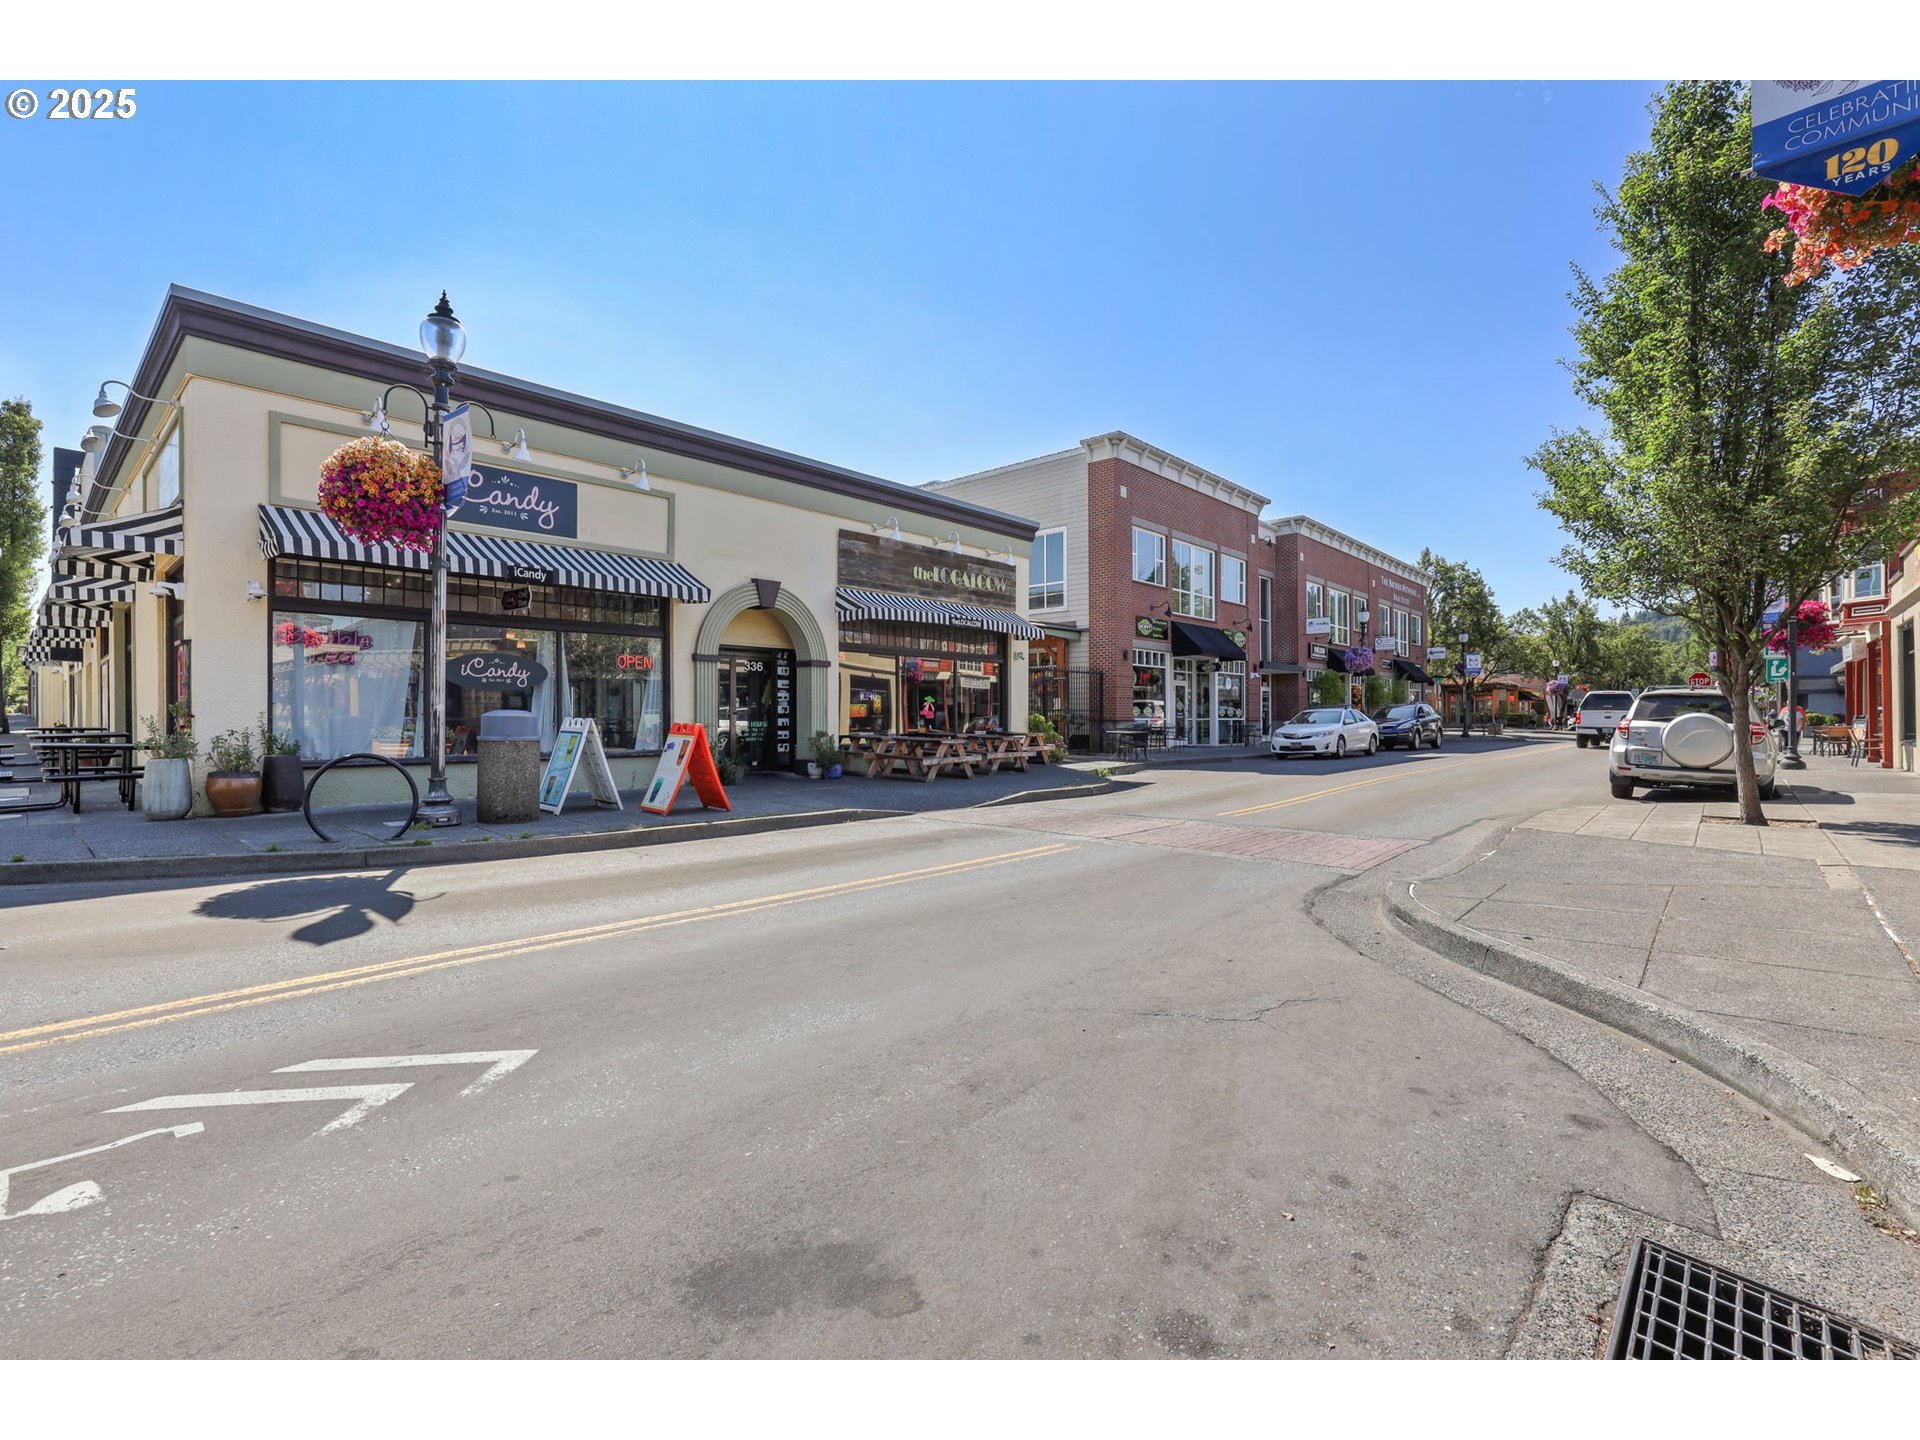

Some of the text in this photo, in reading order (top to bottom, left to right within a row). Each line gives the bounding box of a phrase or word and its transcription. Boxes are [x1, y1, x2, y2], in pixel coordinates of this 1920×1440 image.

[1824, 137, 1899, 181] 120
[1832, 162, 1891, 187] YEARS
[503, 509, 517, 517] 2011
[514, 566, 547, 583] iCandy
[617, 655, 653, 669] OPEN
[744, 661, 764, 672] 336
[461, 657, 530, 687] iCandy
[1690, 677, 1710, 686] STOP
[777, 666, 790, 752] BURGERS
